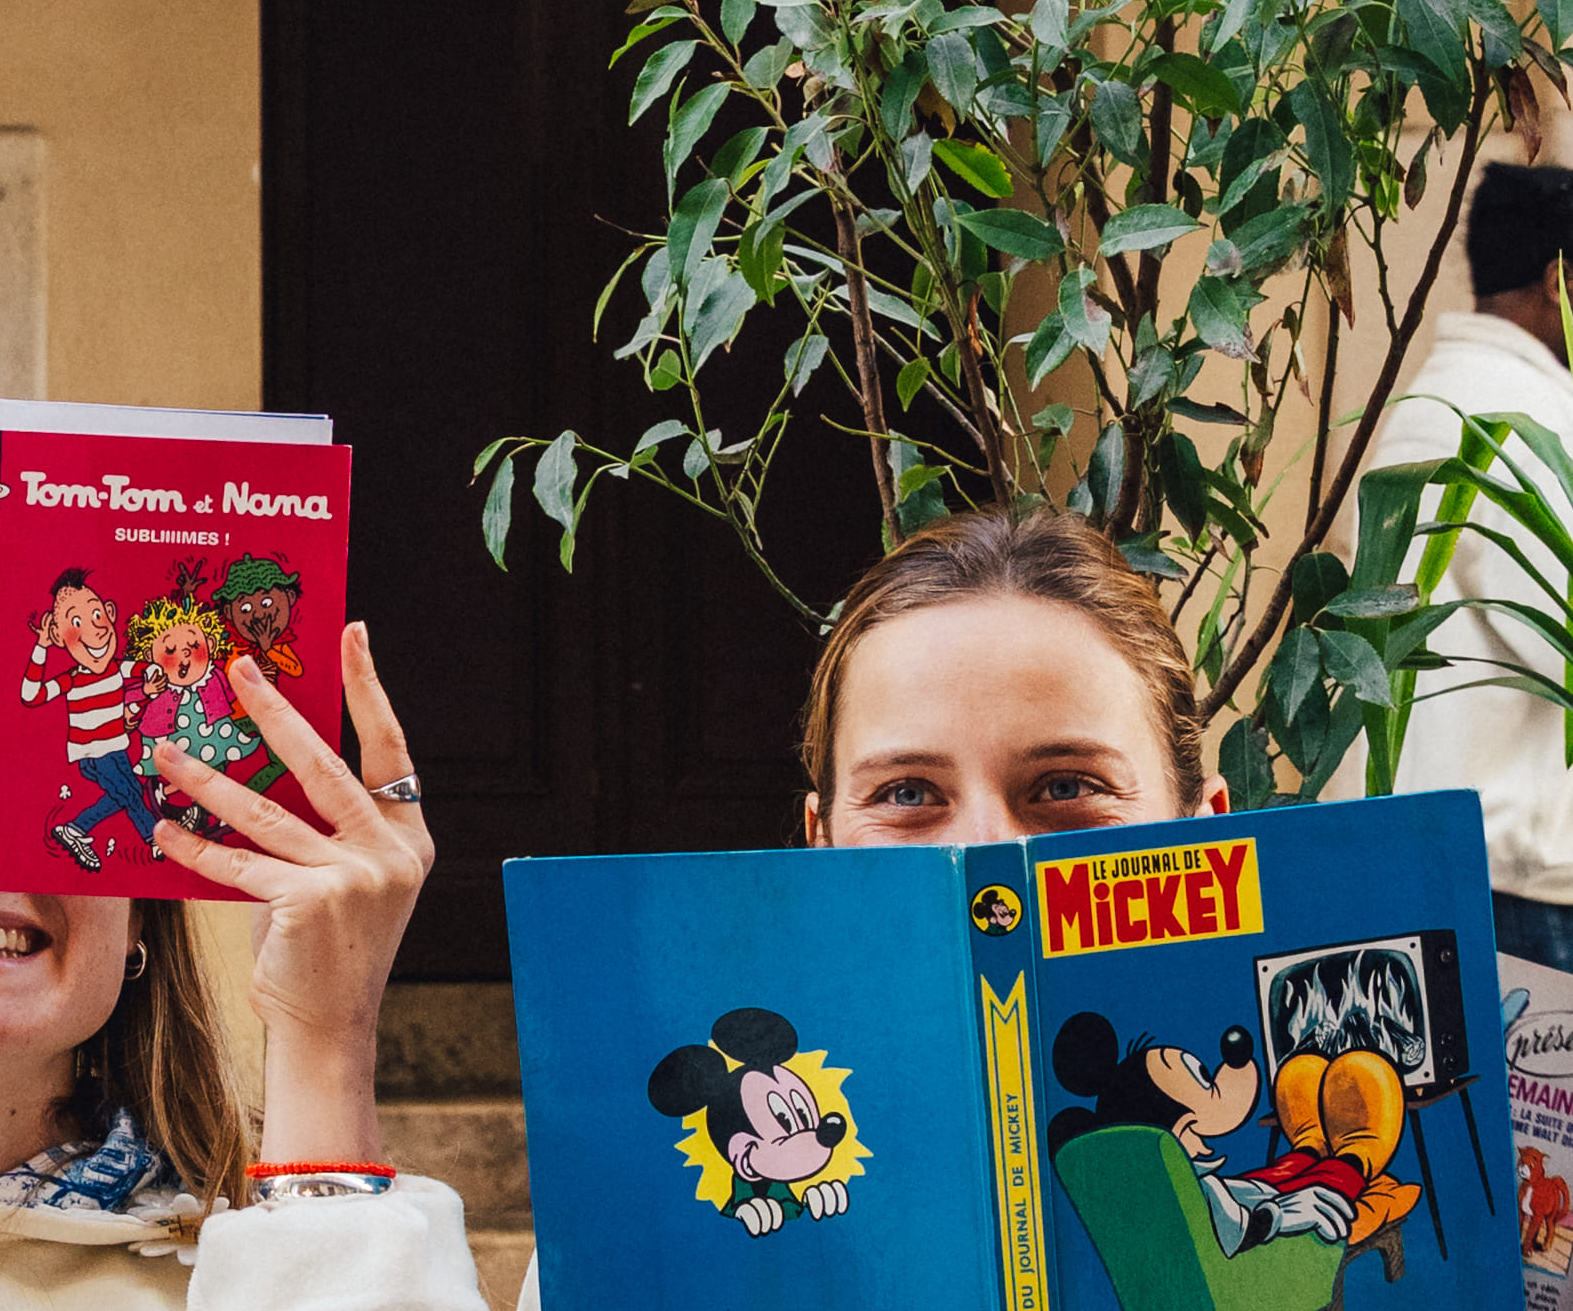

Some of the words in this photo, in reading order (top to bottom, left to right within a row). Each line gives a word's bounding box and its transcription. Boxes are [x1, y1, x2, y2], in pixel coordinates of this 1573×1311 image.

[20, 471, 186, 512] Tom-Tom
[193, 495, 213, 514] et
[222, 481, 332, 520] Nana
[1093, 860, 1106, 881] LE
[1112, 853, 1180, 878] JOURNAL
[1184, 849, 1201, 869] DE
[1006, 1093, 1023, 1154] MICKEY
[1012, 1165, 1024, 1187] DE
[1014, 1198, 1032, 1274] JOURNAL
[1022, 1284, 1034, 1310] DU
